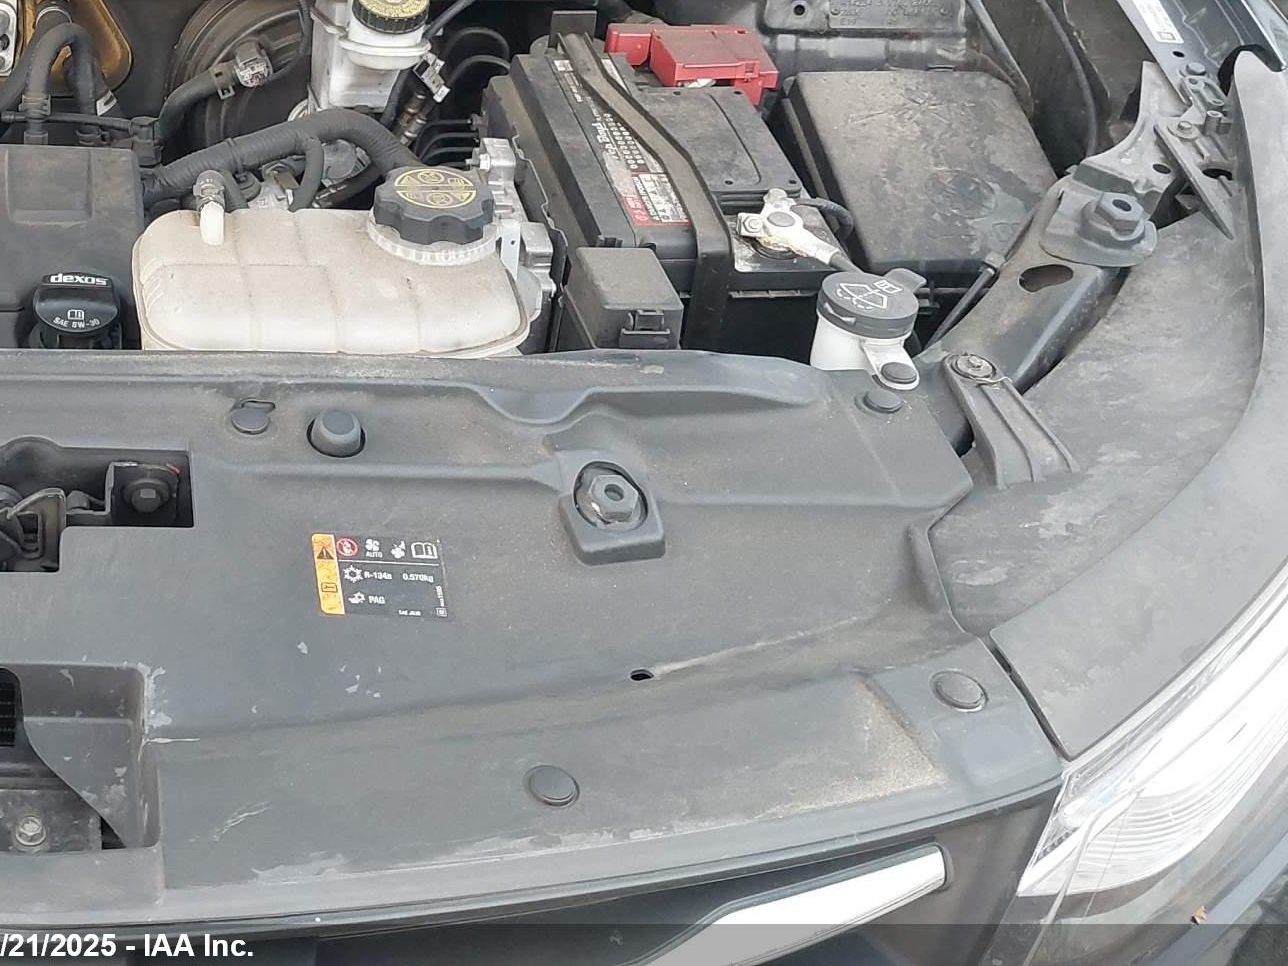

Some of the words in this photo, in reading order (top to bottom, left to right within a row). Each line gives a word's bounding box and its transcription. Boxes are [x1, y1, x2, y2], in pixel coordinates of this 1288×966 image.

[50, 273, 109, 285] dexos
[53, 317, 70, 328] SAE
[368, 595, 386, 605] PAG
